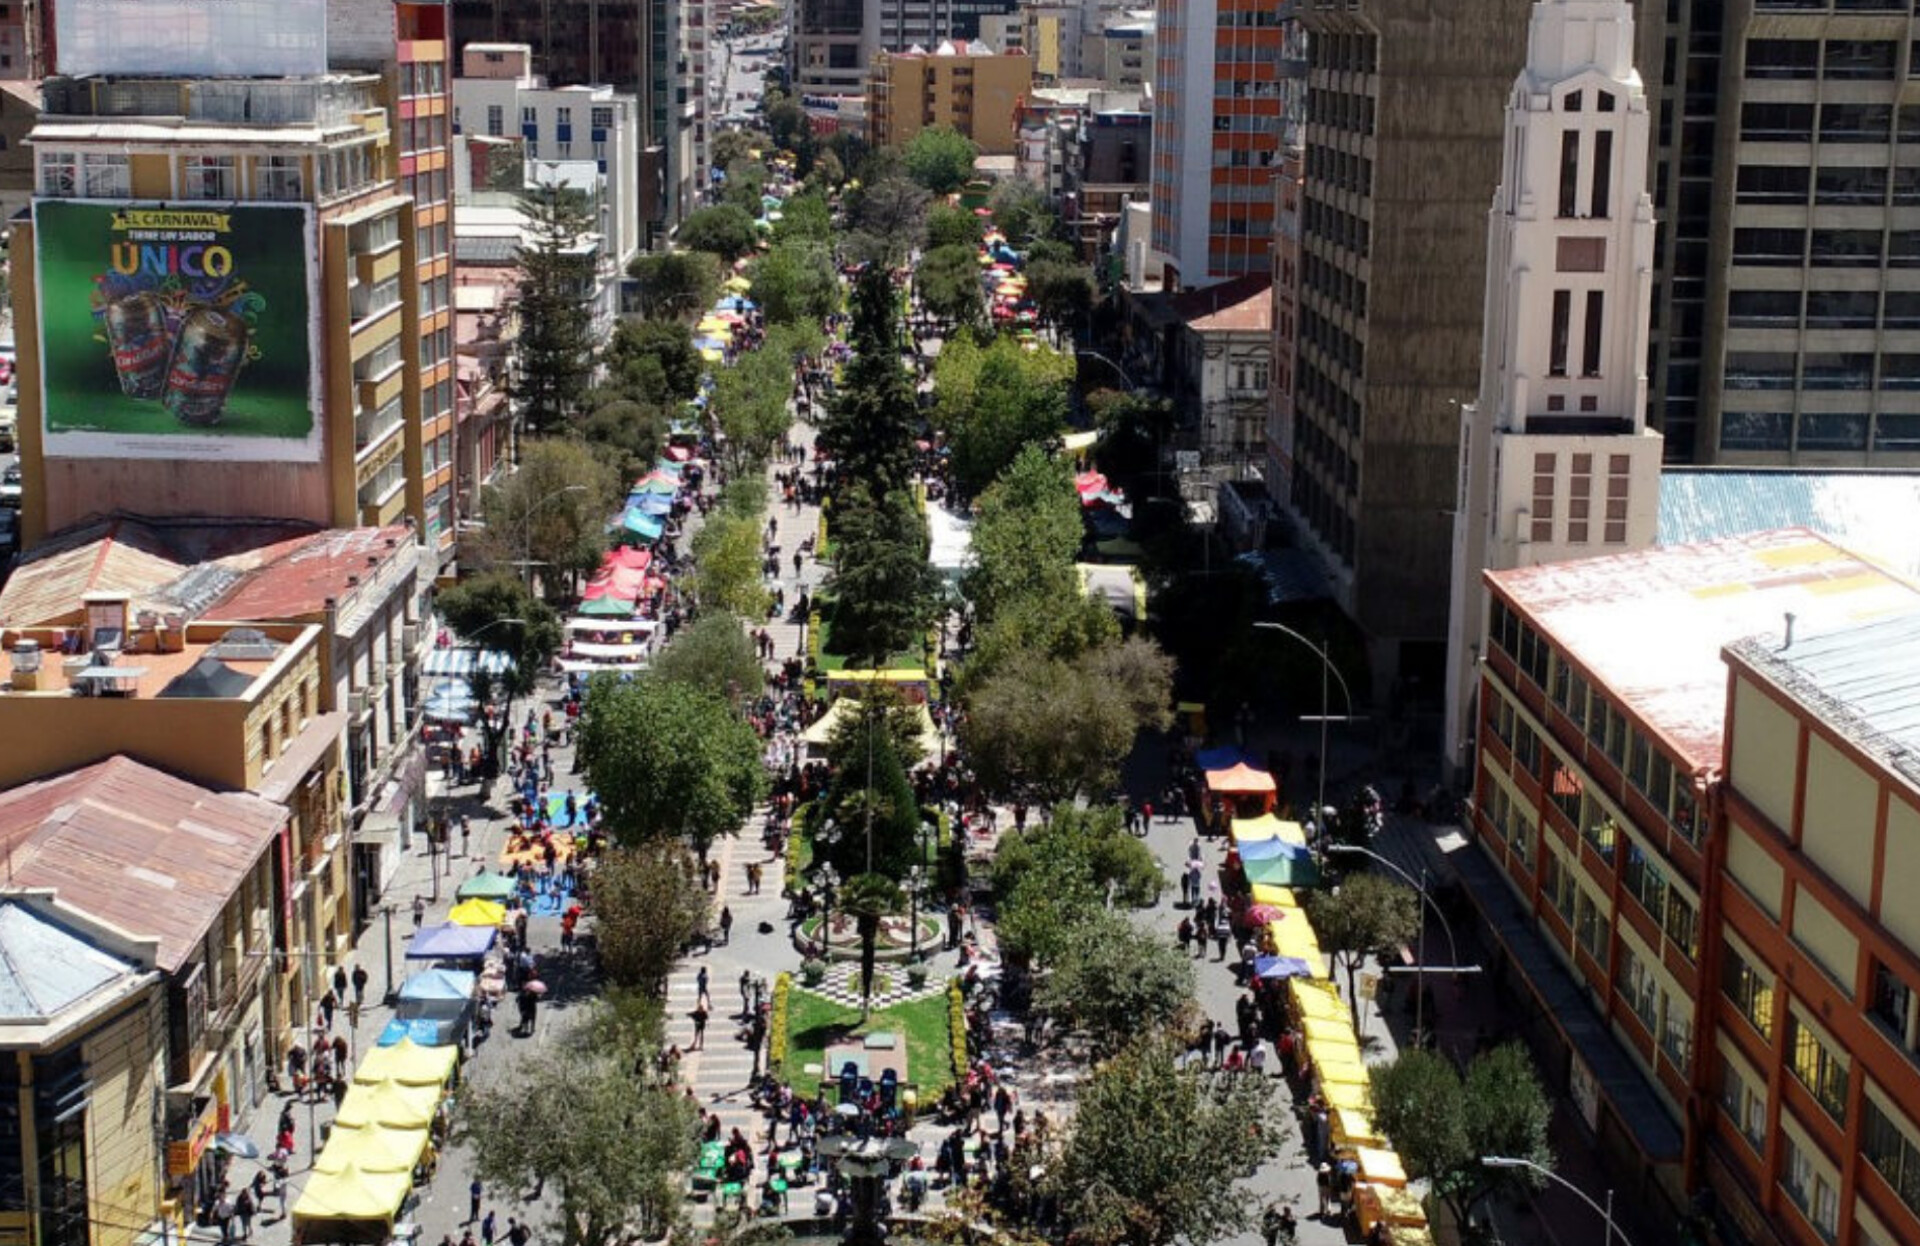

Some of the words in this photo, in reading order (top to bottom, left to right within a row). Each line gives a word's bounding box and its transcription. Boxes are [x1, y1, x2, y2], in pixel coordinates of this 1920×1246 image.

[124, 213, 139, 224] EL
[142, 214, 217, 226] CARNAVAL
[179, 231, 216, 241] SABOR
